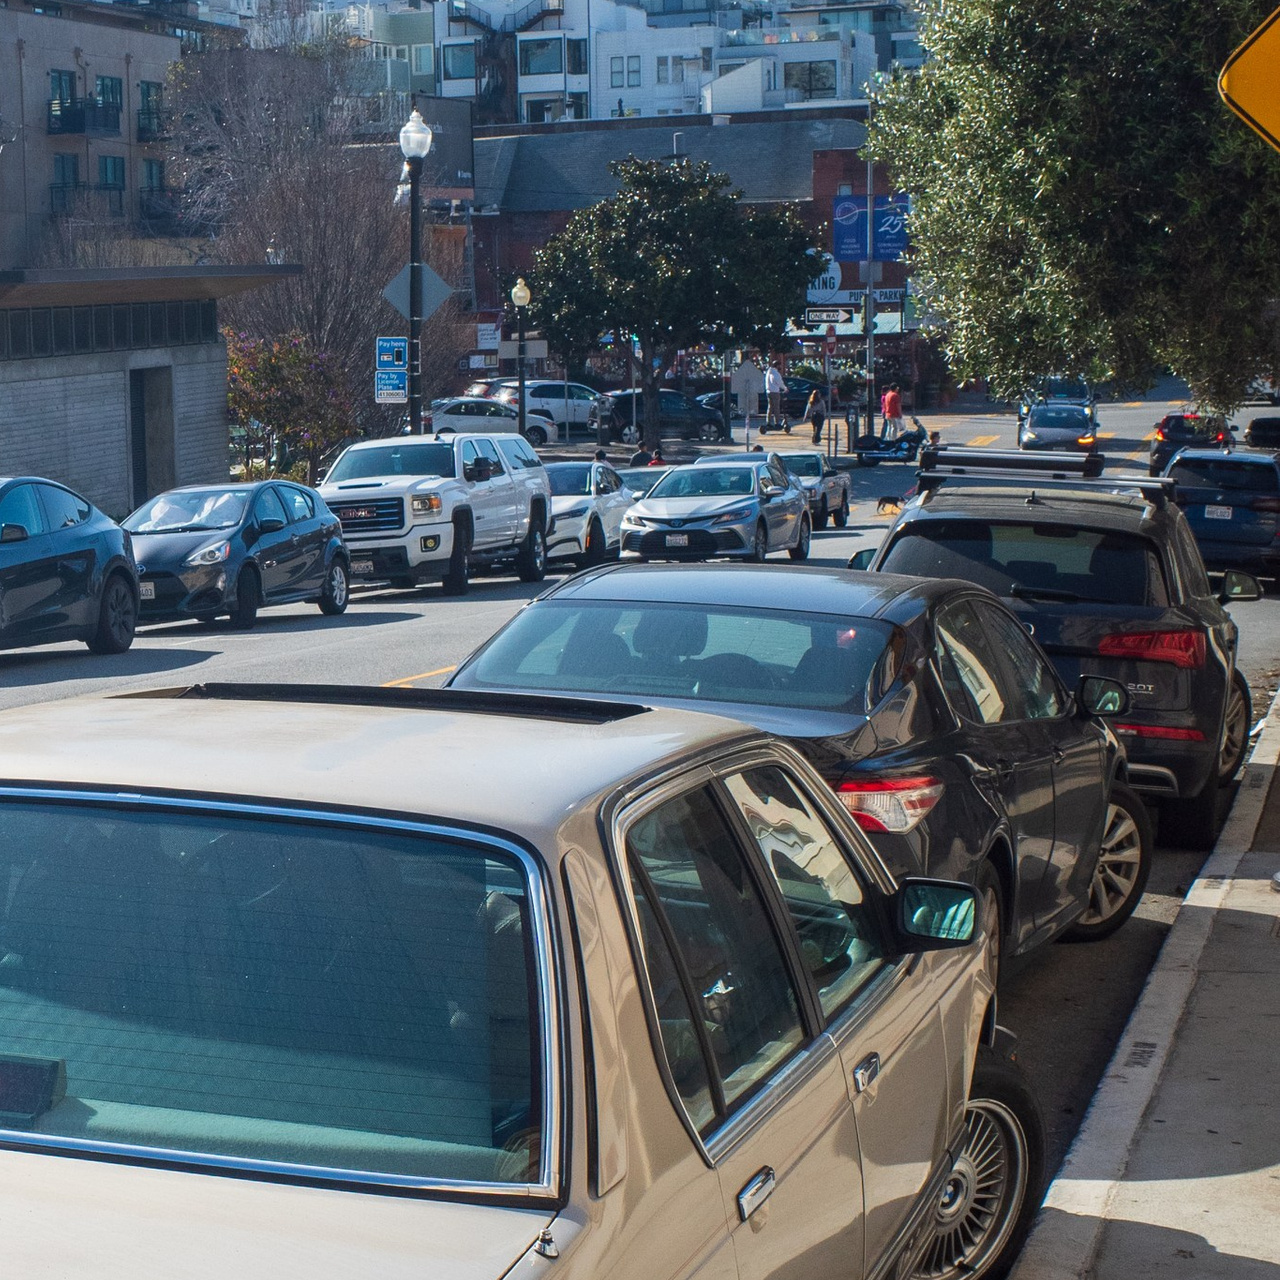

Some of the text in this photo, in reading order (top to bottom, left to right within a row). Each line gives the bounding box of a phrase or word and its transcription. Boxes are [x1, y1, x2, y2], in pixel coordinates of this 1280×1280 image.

[878, 215, 907, 234] 25
[810, 312, 824, 320] ONE
[340, 507, 377, 519] GMC
